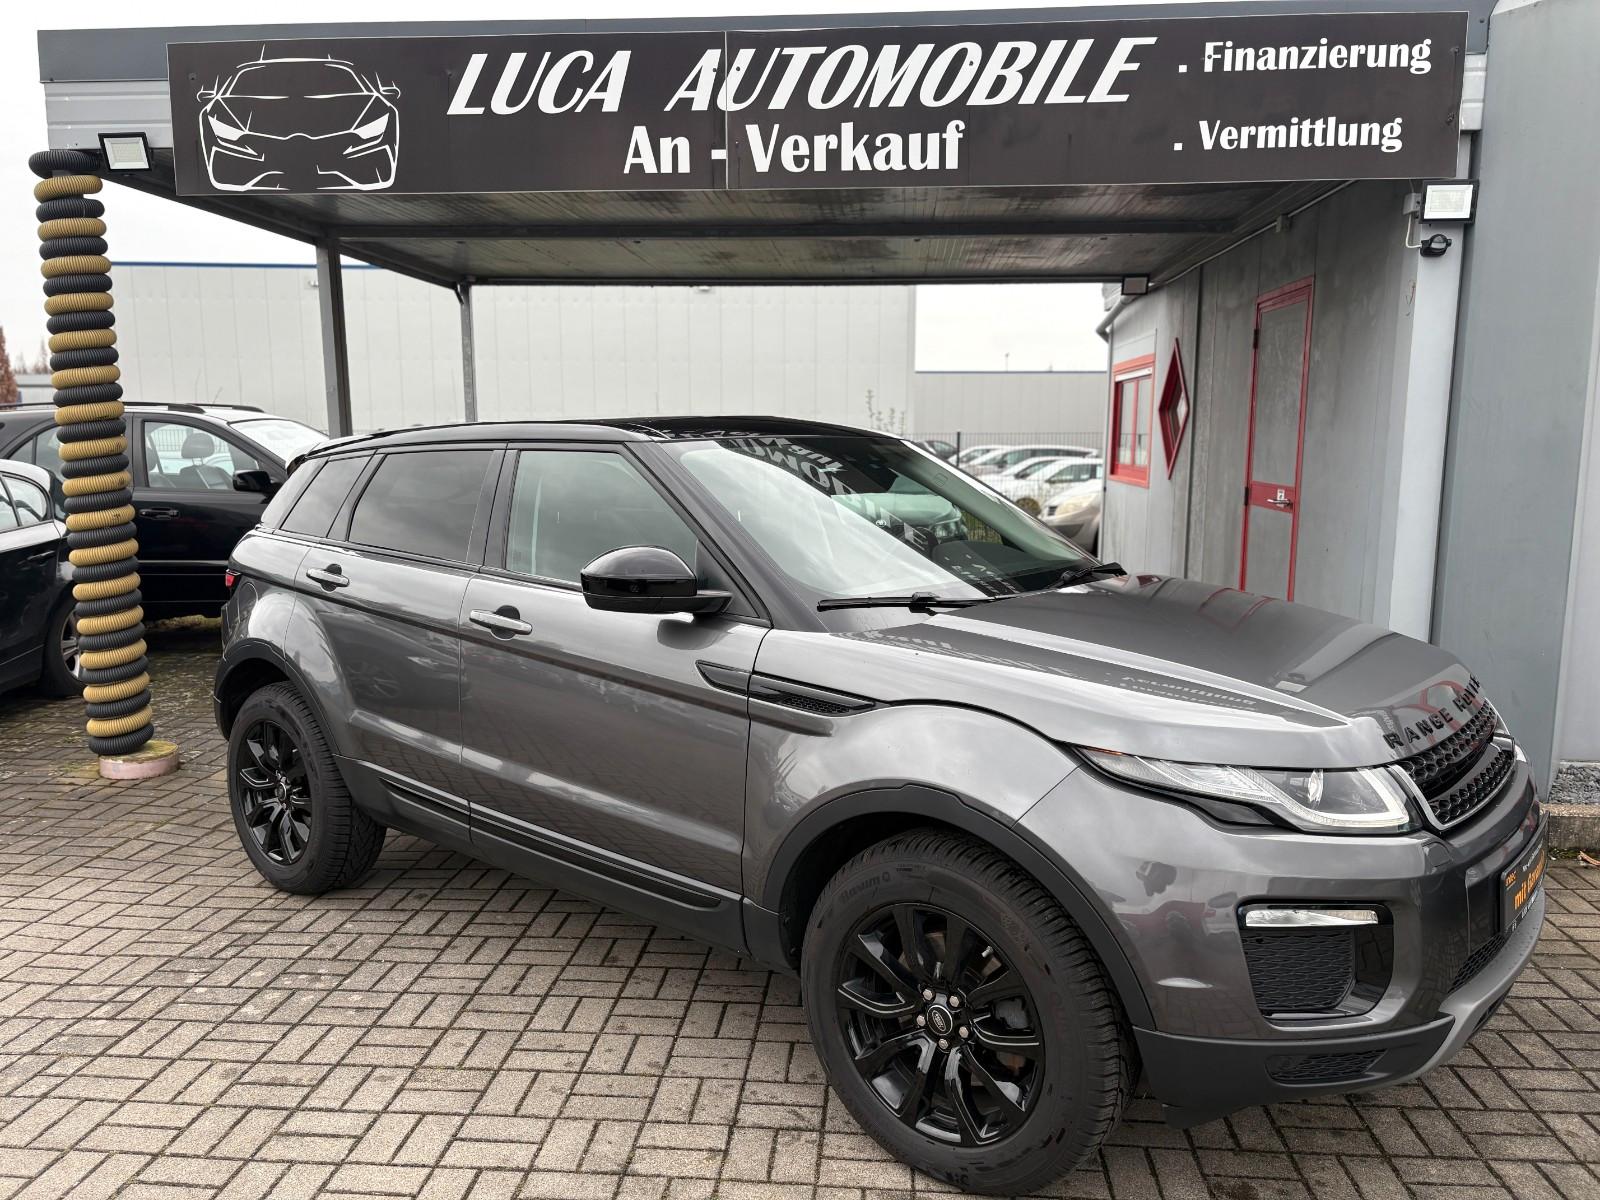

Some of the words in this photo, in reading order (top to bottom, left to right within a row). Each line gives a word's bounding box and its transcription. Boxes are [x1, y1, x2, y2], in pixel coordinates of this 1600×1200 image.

[447, 50, 631, 115] LUCA
[664, 36, 1158, 113] AUTOMOBILE
[1203, 38, 1432, 75] Finanzierung
[623, 125, 691, 174] An
[745, 119, 965, 173] Verkauf
[1198, 116, 1403, 154] Vermittlung
[1383, 707, 1453, 749] RANGE
